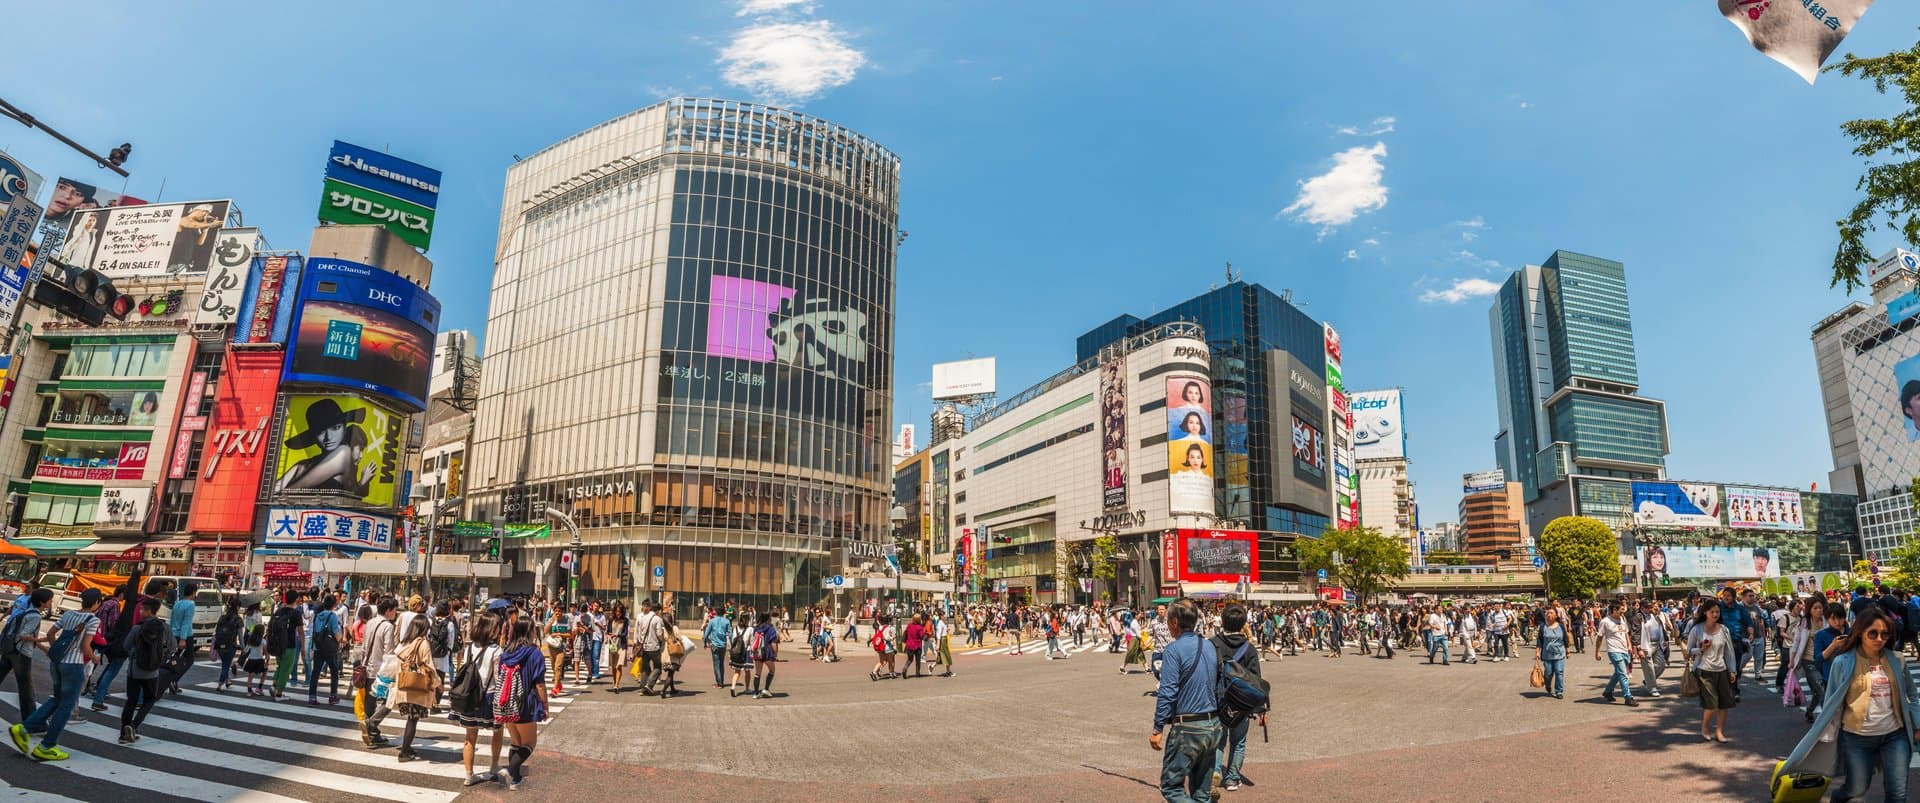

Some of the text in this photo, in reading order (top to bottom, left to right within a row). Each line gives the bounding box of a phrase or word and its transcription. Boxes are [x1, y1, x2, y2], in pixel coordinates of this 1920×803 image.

[332, 154, 439, 193] Hisamitsu
[330, 191, 429, 234] サロンパス
[3, 204, 37, 263] 渋谷駅前
[99, 260, 118, 270] 5.4
[119, 262, 131, 270] ON
[201, 237, 250, 319] もんじゃ
[318, 263, 371, 276] DHC Channel
[368, 288, 402, 307] DHC
[364, 382, 378, 391] DHC
[204, 416, 269, 481] クスリ
[367, 408, 387, 458] FX
[379, 415, 401, 484] DMM
[120, 446, 147, 464] JTB
[567, 480, 635, 499] TSUTAYA
[274, 514, 389, 544] 大盛堂書店
